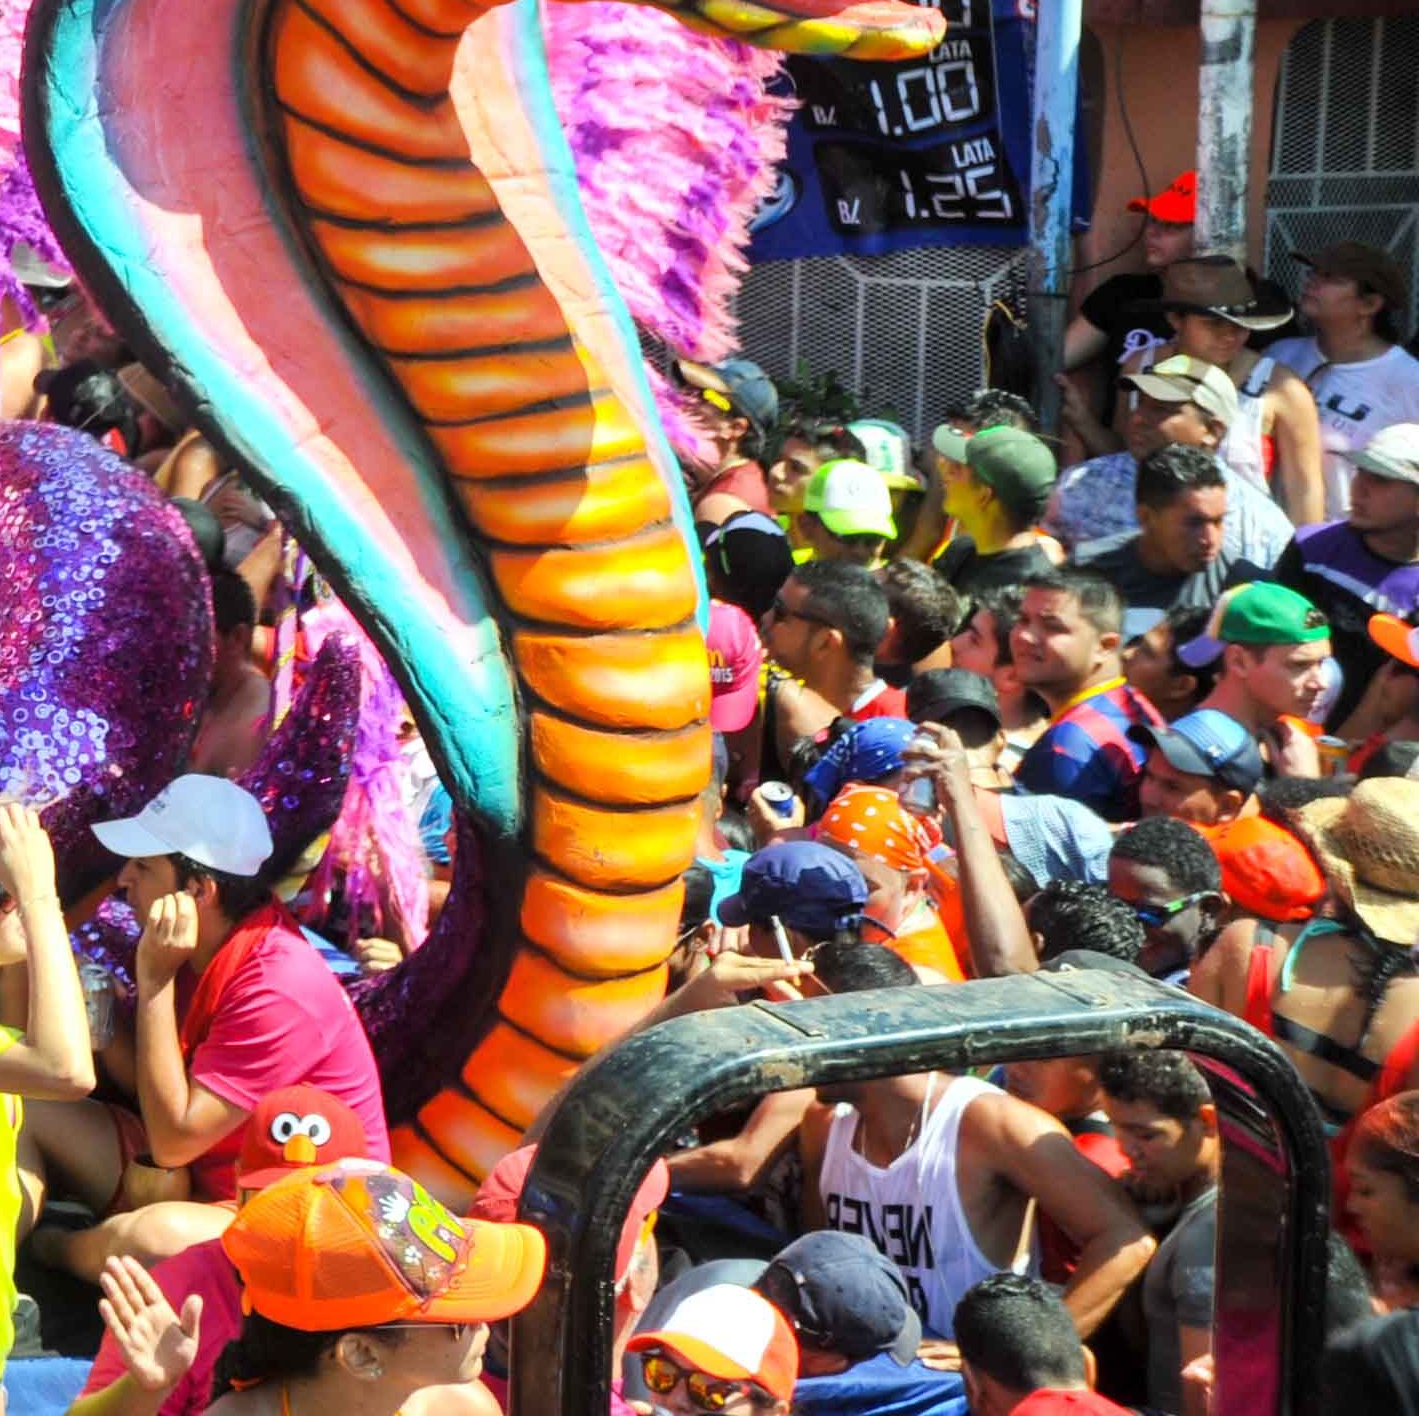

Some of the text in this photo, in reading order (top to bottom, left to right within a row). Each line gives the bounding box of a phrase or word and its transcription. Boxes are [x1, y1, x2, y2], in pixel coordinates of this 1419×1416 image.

[928, 40, 972, 63] LATA
[869, 59, 980, 136] 1.00
[951, 137, 996, 168] LATA
[899, 164, 1012, 219] 1.25
